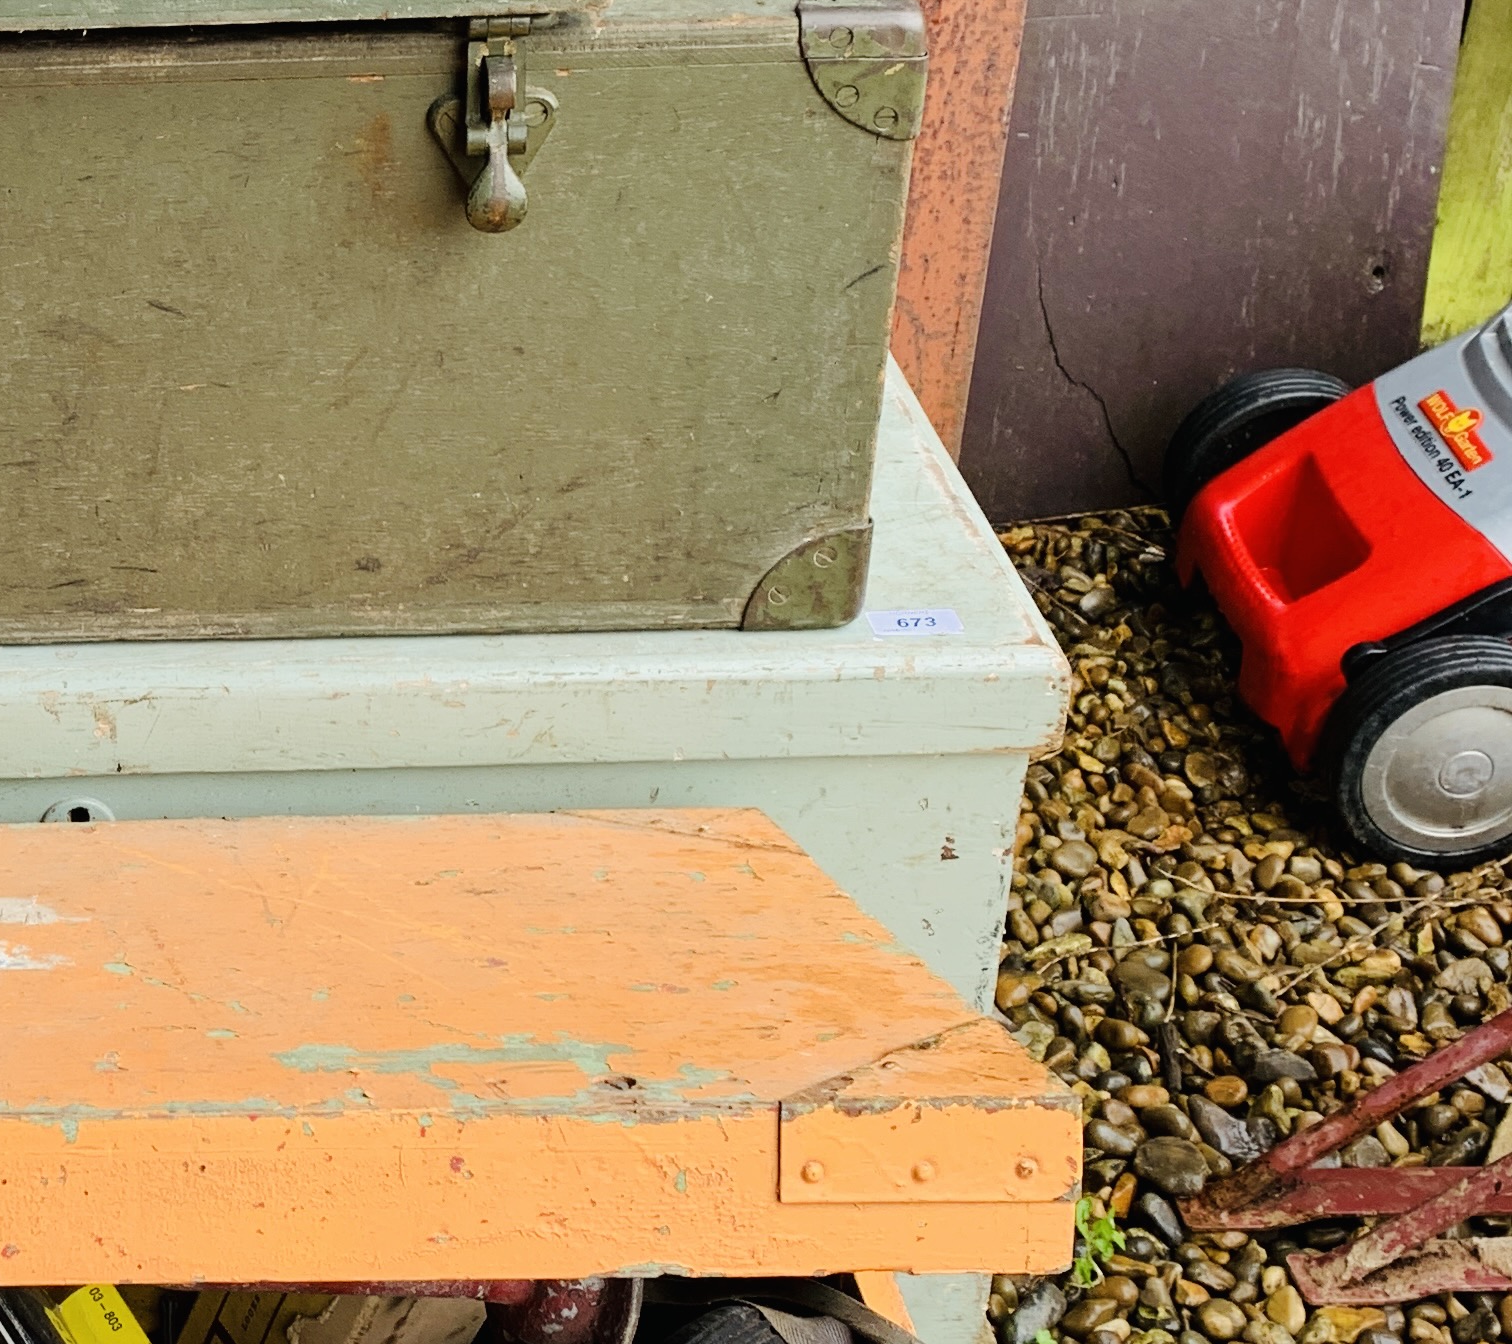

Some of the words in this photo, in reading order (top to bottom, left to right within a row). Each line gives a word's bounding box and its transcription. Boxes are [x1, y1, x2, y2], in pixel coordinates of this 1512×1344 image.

[1426, 394, 1455, 420] WOLF
[1391, 396, 1417, 425] Power
[1411, 425, 1441, 459] edition
[1437, 458, 1453, 472] 40
[1445, 470, 1472, 499] EA-1
[897, 617, 937, 628] 673
